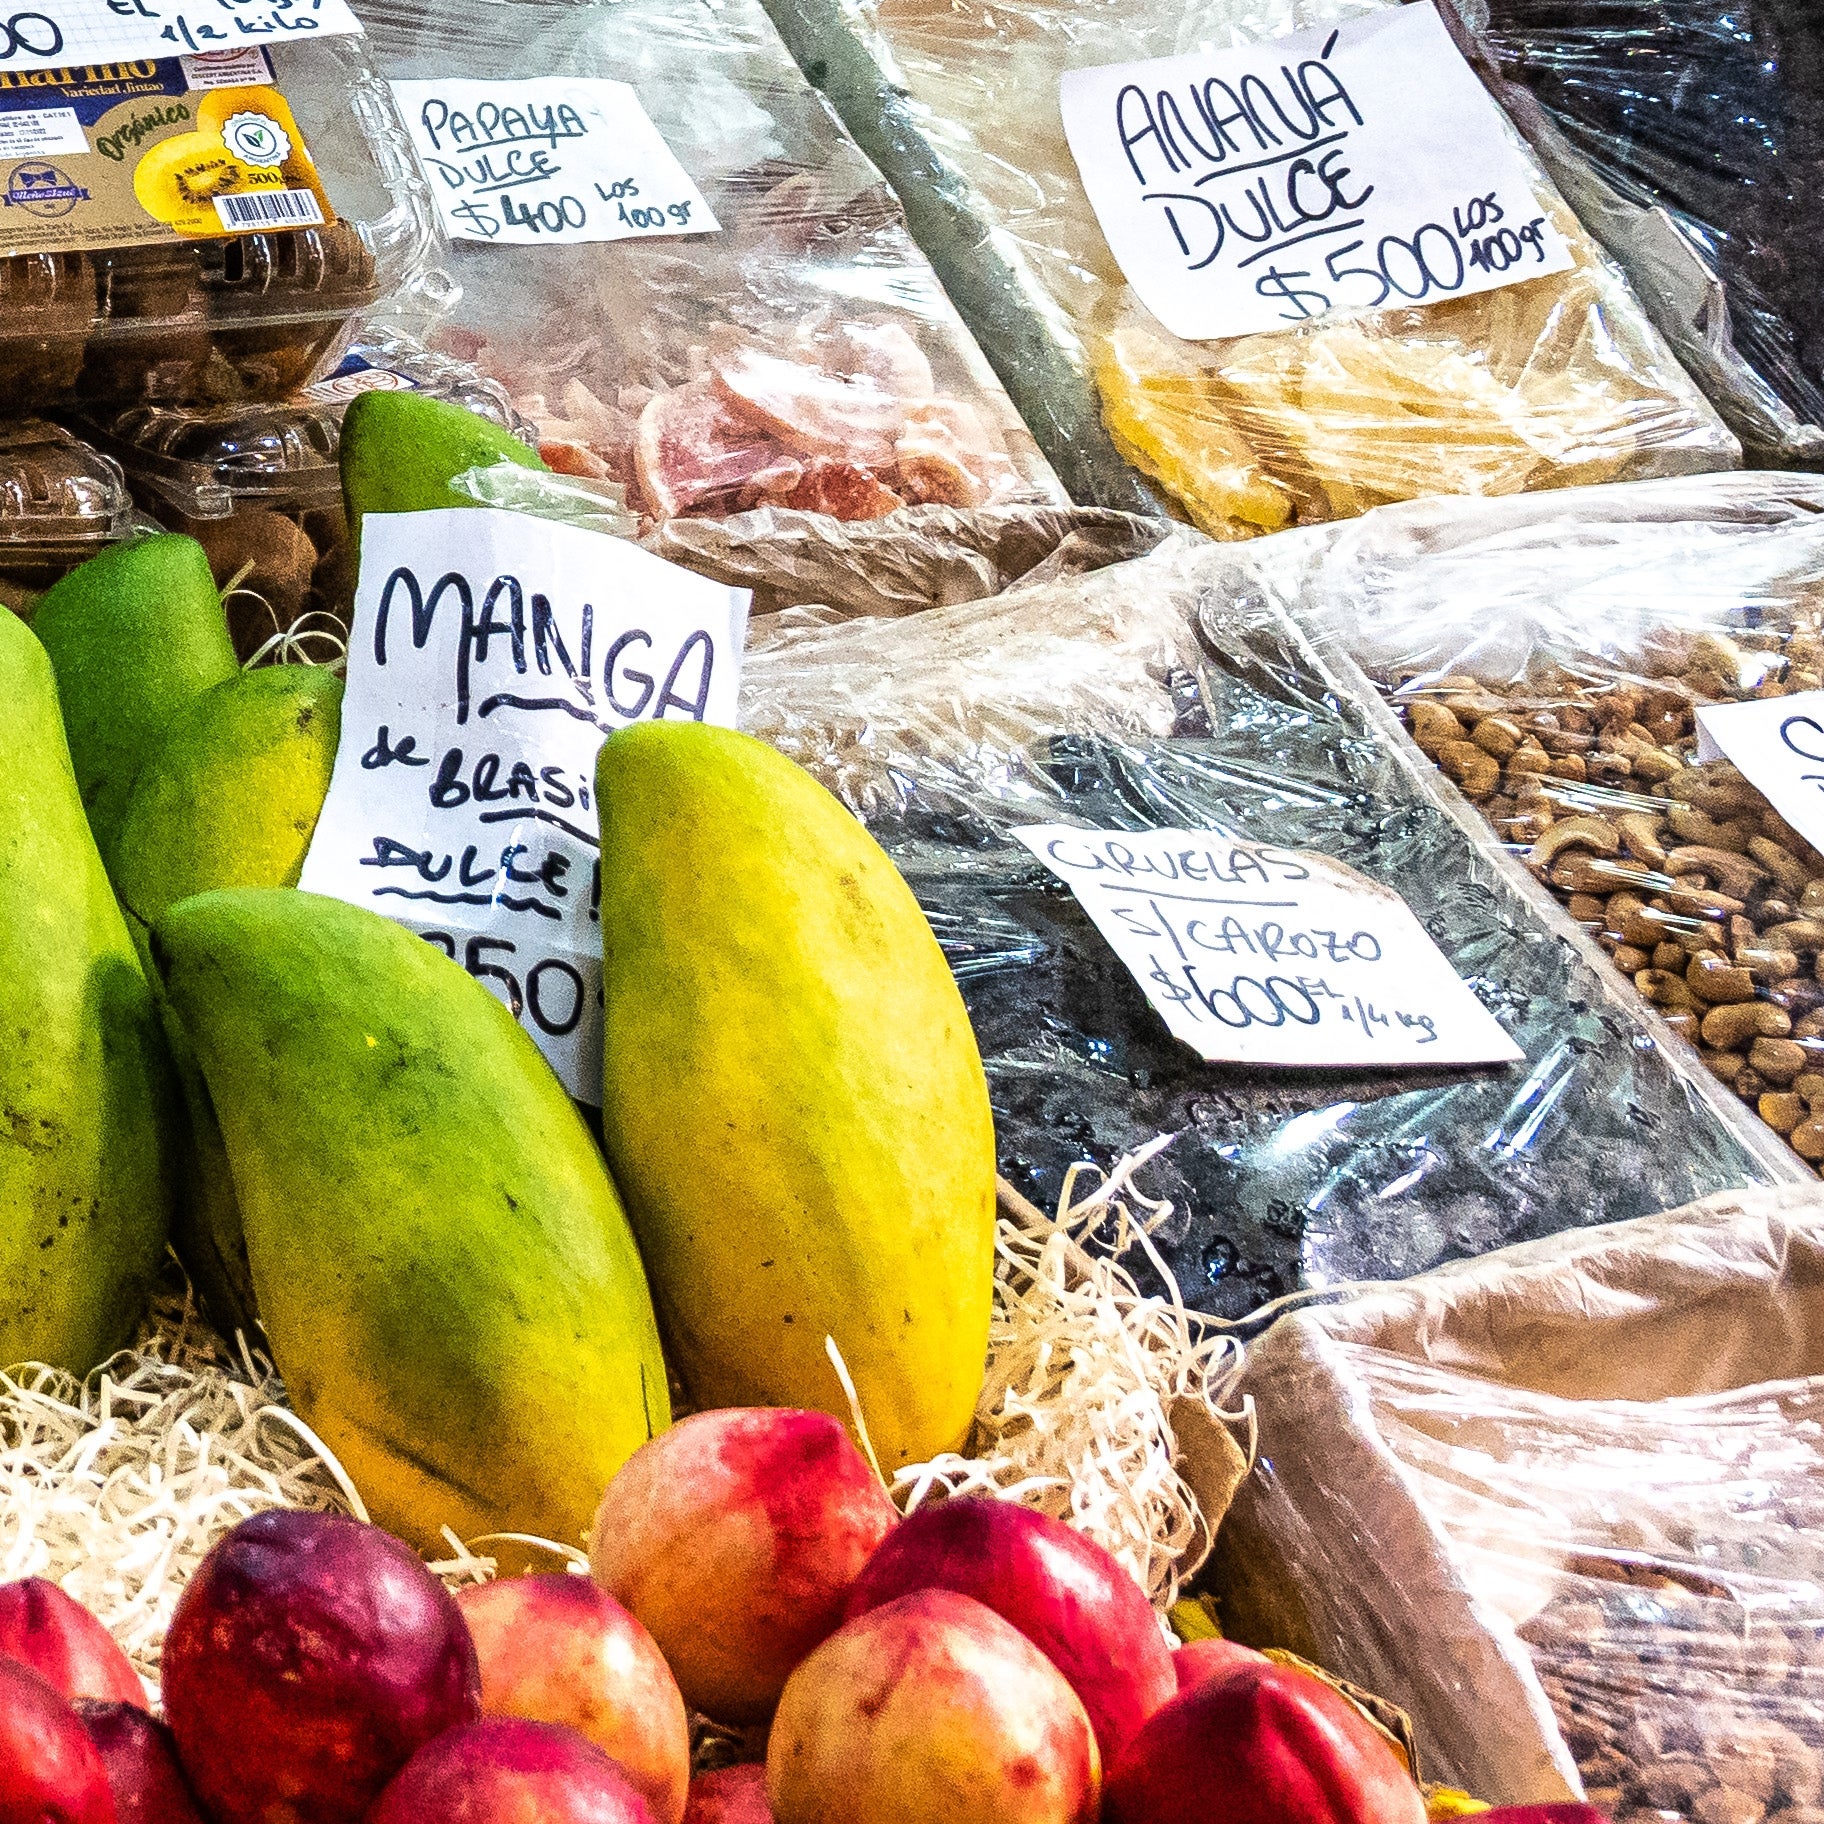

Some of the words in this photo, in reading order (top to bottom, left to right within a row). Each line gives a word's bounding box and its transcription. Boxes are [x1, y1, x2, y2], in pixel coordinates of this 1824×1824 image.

[160, 15, 227, 51] 1/2
[61, 85, 121, 98] Variedad
[1116, 29, 1364, 185] ANANÁ
[95, 102, 192, 163] Orgánico
[421, 98, 589, 150] PAPAYA
[423, 150, 561, 190] DULCE
[451, 194, 587, 239] $400
[1143, 149, 1375, 270] DULCE
[1256, 222, 1463, 320] $500
[373, 566, 714, 725] MANGA
[360, 725, 429, 770] de
[1148, 954, 1321, 1030] $600
